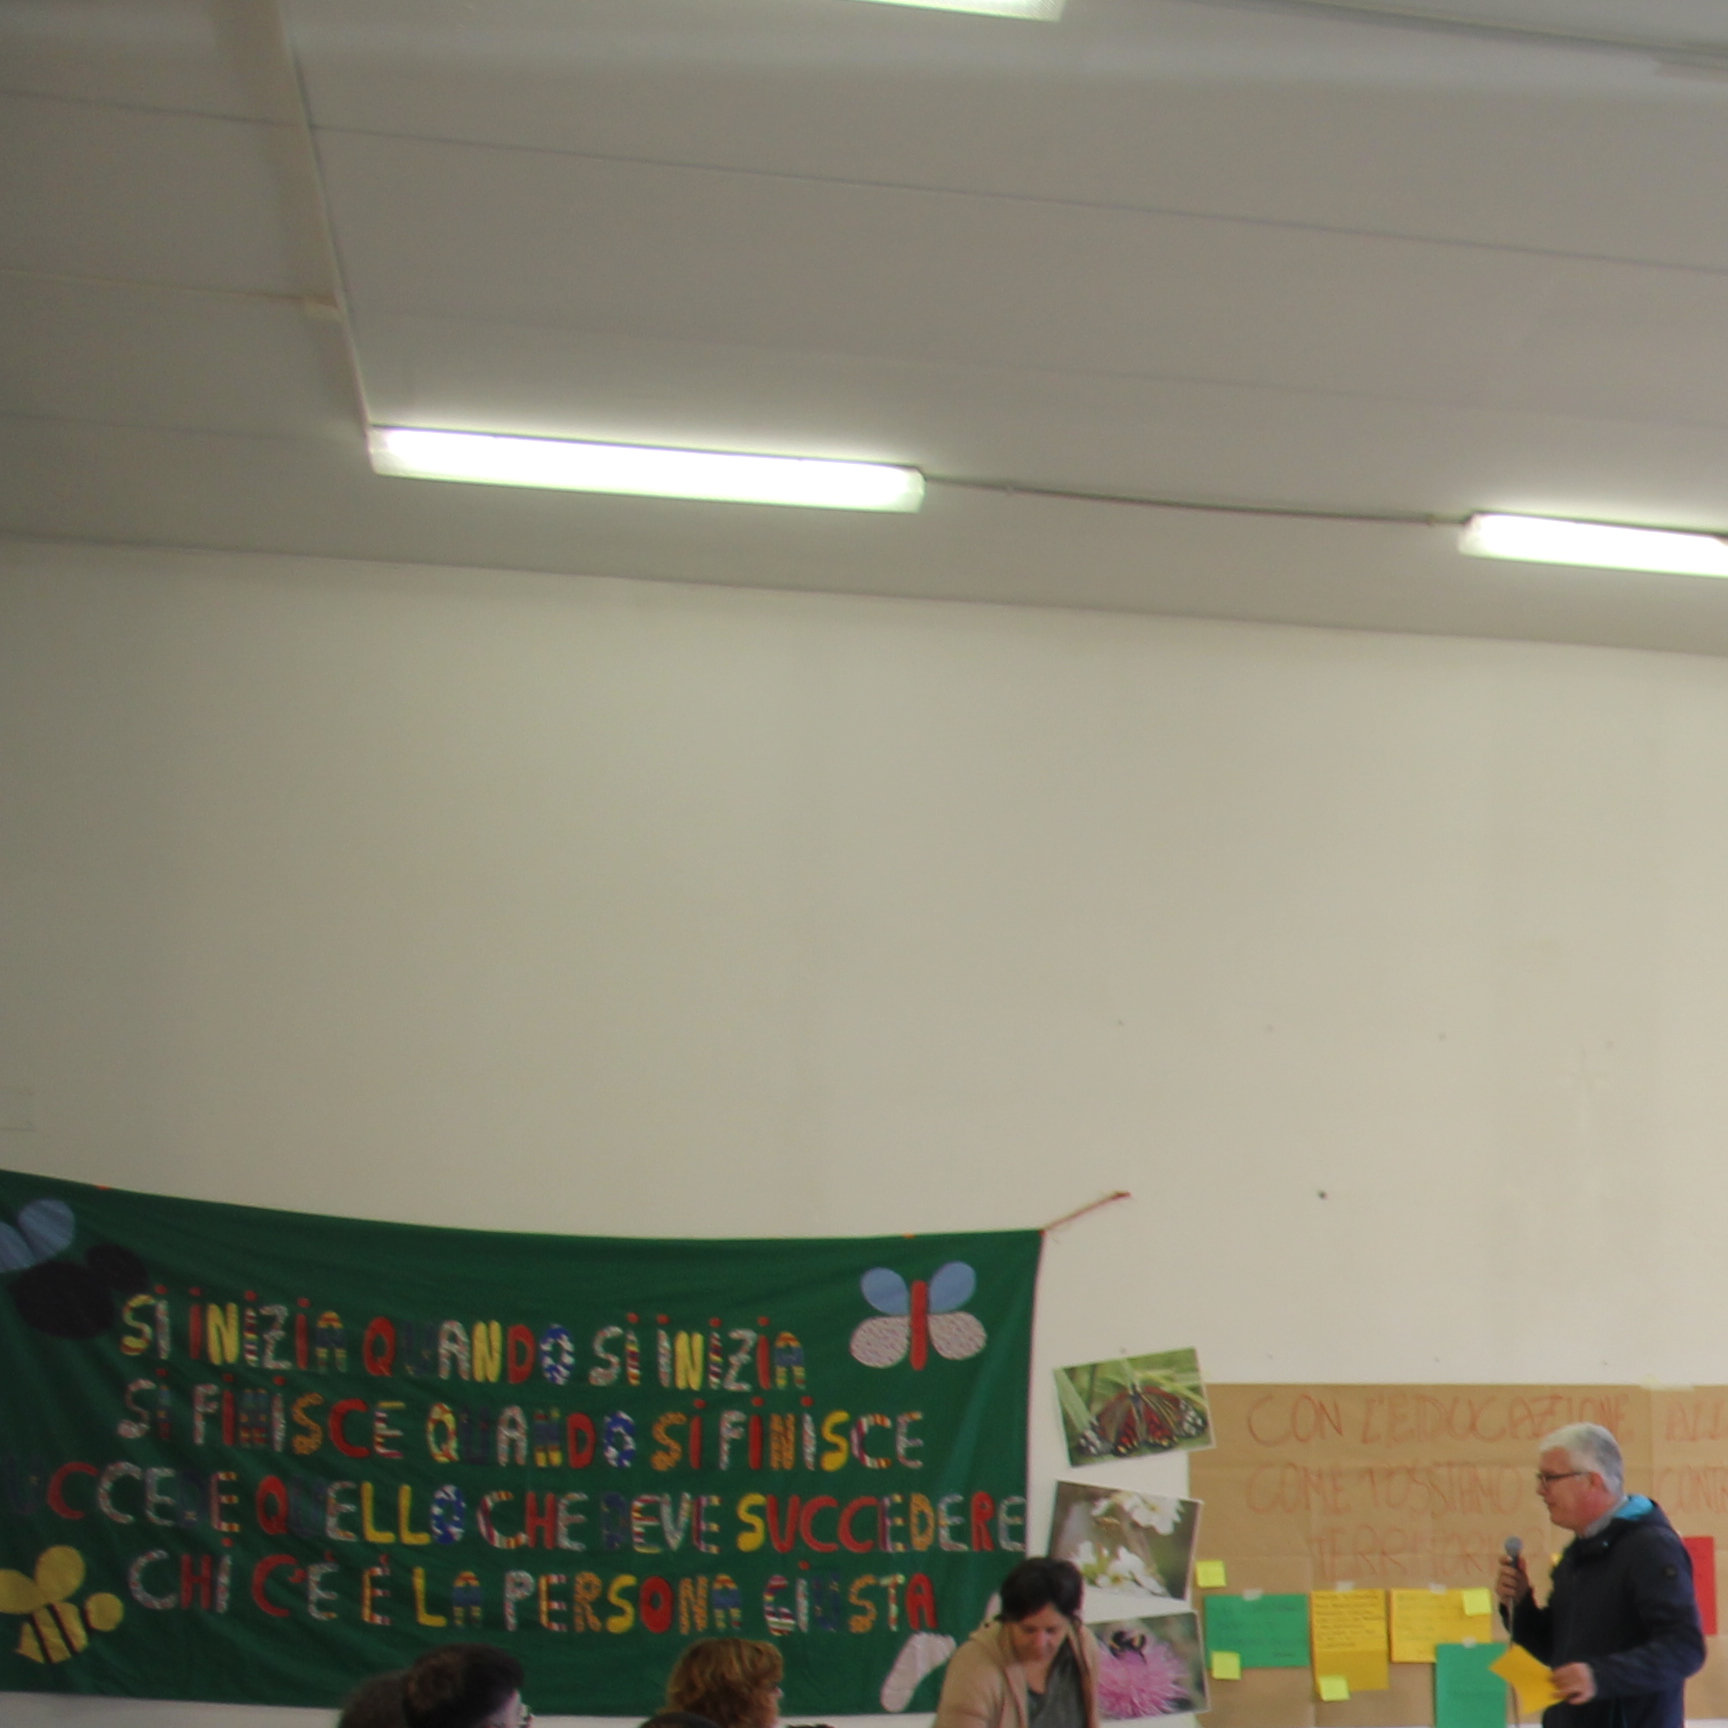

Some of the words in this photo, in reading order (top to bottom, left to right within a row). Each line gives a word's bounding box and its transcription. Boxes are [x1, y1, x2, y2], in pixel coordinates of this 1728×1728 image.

[118, 1284, 171, 1360] SI
[188, 1287, 349, 1373] INIZIA
[362, 1314, 577, 1387] QUANDO
[587, 1312, 642, 1388] SI
[656, 1313, 807, 1391] INIZIA
[116, 1367, 174, 1441] SI
[192, 1373, 407, 1459] FINISCE
[426, 1401, 637, 1469] QUANDO
[650, 1398, 706, 1472] SI
[719, 1395, 926, 1472] FINISCE
[1247, 1393, 1343, 1448] CON
[2, 1453, 241, 1534] UCCEDE
[255, 1475, 468, 1546] QUELLO
[476, 1490, 590, 1551] CHE
[600, 1492, 722, 1554] DEVE
[736, 1490, 1027, 1555] SUCCEDERE
[1245, 1461, 1351, 1516] COME
[127, 1537, 233, 1615] CHI
[412, 1566, 484, 1628] LA
[503, 1570, 742, 1636] PERSONA
[762, 1559, 939, 1637] GIUSTA
